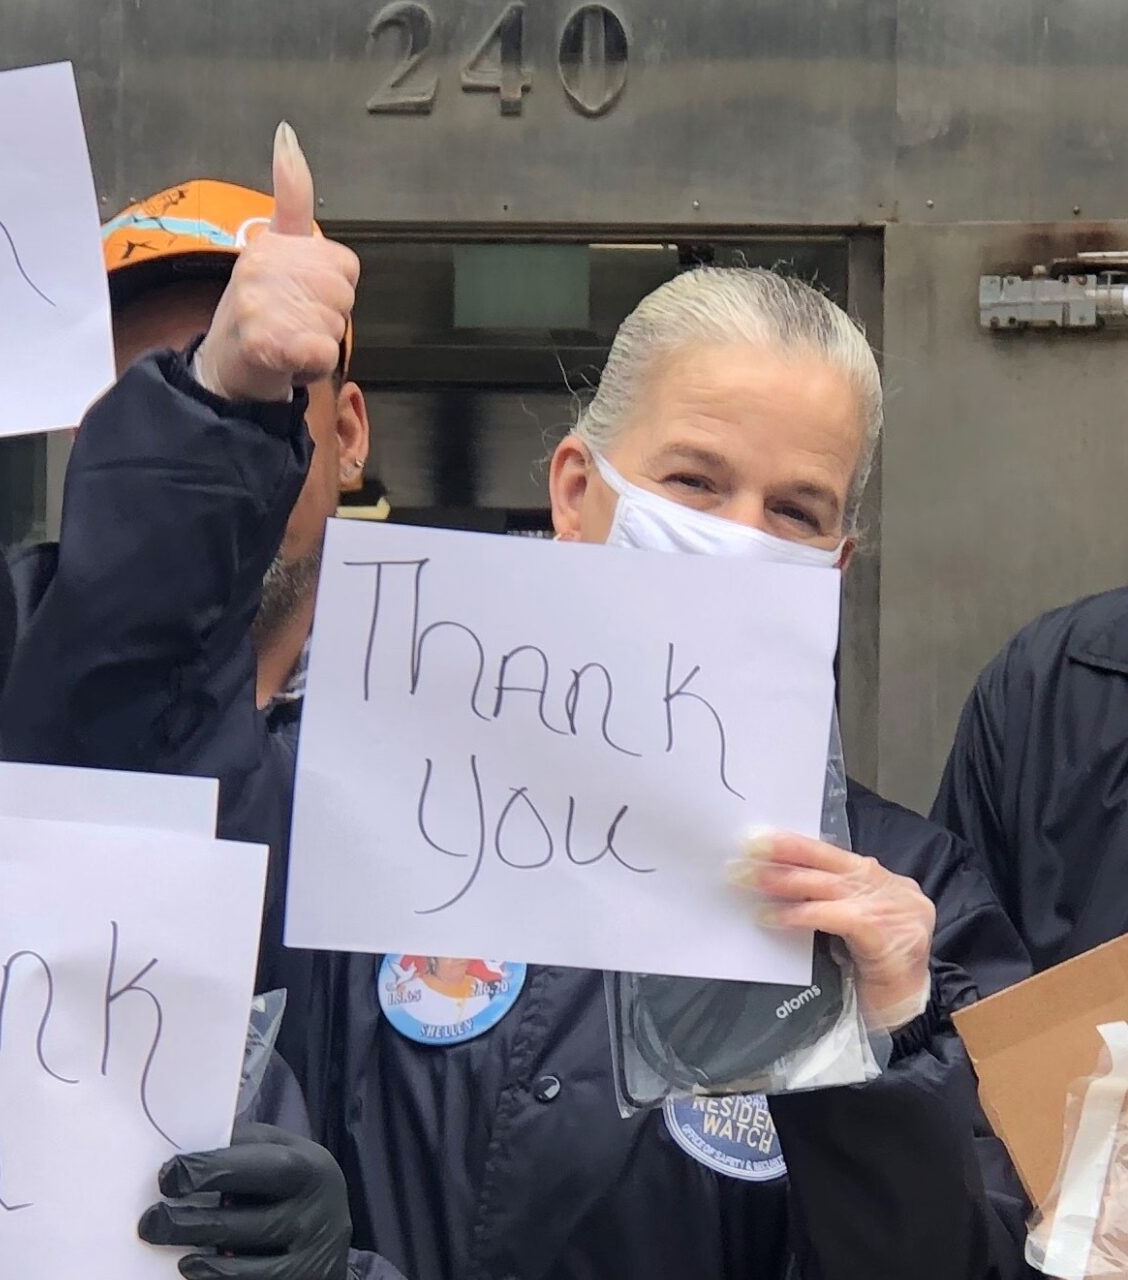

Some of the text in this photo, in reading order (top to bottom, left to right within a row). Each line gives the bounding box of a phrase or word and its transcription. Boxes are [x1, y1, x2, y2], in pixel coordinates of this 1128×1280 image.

[366, 1, 631, 119] 240
[775, 984, 821, 1019] atoms
[421, 1018, 474, 1039] SHELLEY
[682, 1123, 706, 1149] OFFICE
[702, 1142, 716, 1160] OF
[713, 1150, 746, 1170] SAFETY
[702, 1113, 773, 1155] WATCH
